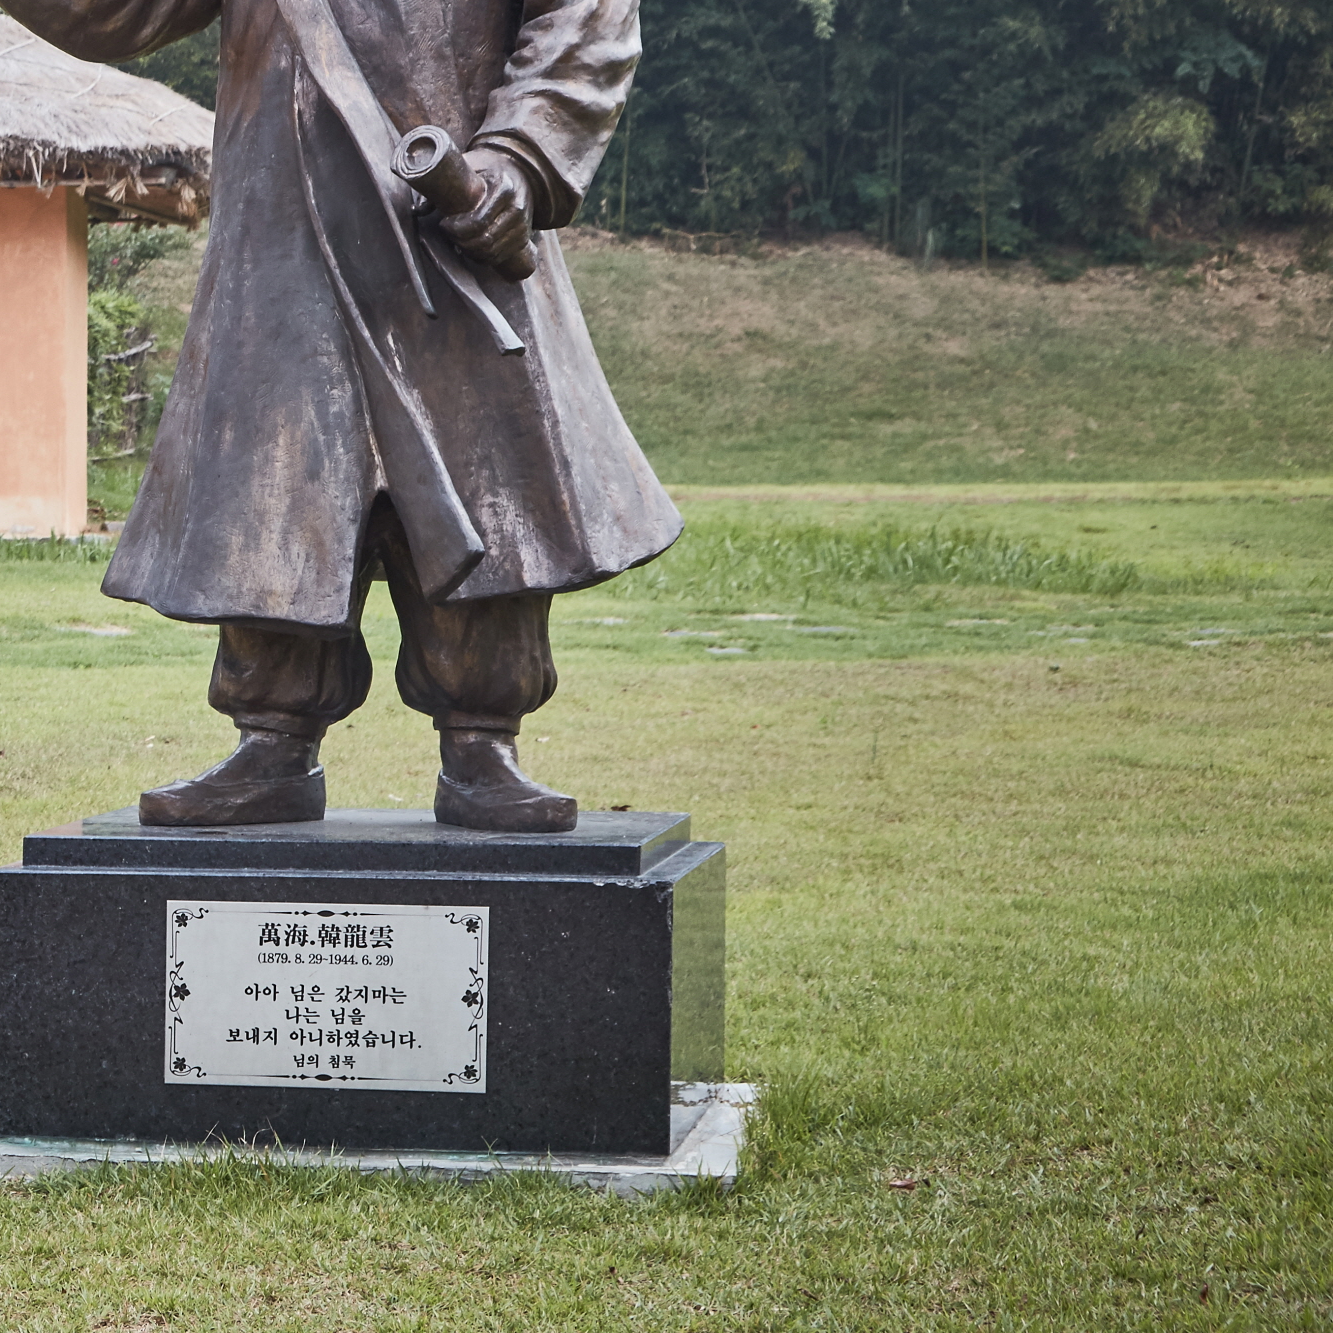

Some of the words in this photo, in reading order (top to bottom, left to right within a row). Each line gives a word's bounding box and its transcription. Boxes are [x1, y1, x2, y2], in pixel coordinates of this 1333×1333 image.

[257, 922, 394, 949] 萬海.韓龍雲
[244, 982, 279, 1002] 아아
[289, 983, 326, 1003] 님은
[334, 984, 408, 1005] 갔지마는
[284, 1005, 321, 1025] 나는
[330, 1006, 366, 1026] 님을
[225, 1026, 279, 1046] 보내지
[289, 1027, 422, 1050] 아니하였습니다.
[292, 1053, 319, 1069] 님의
[328, 1054, 357, 1070] 침묵
